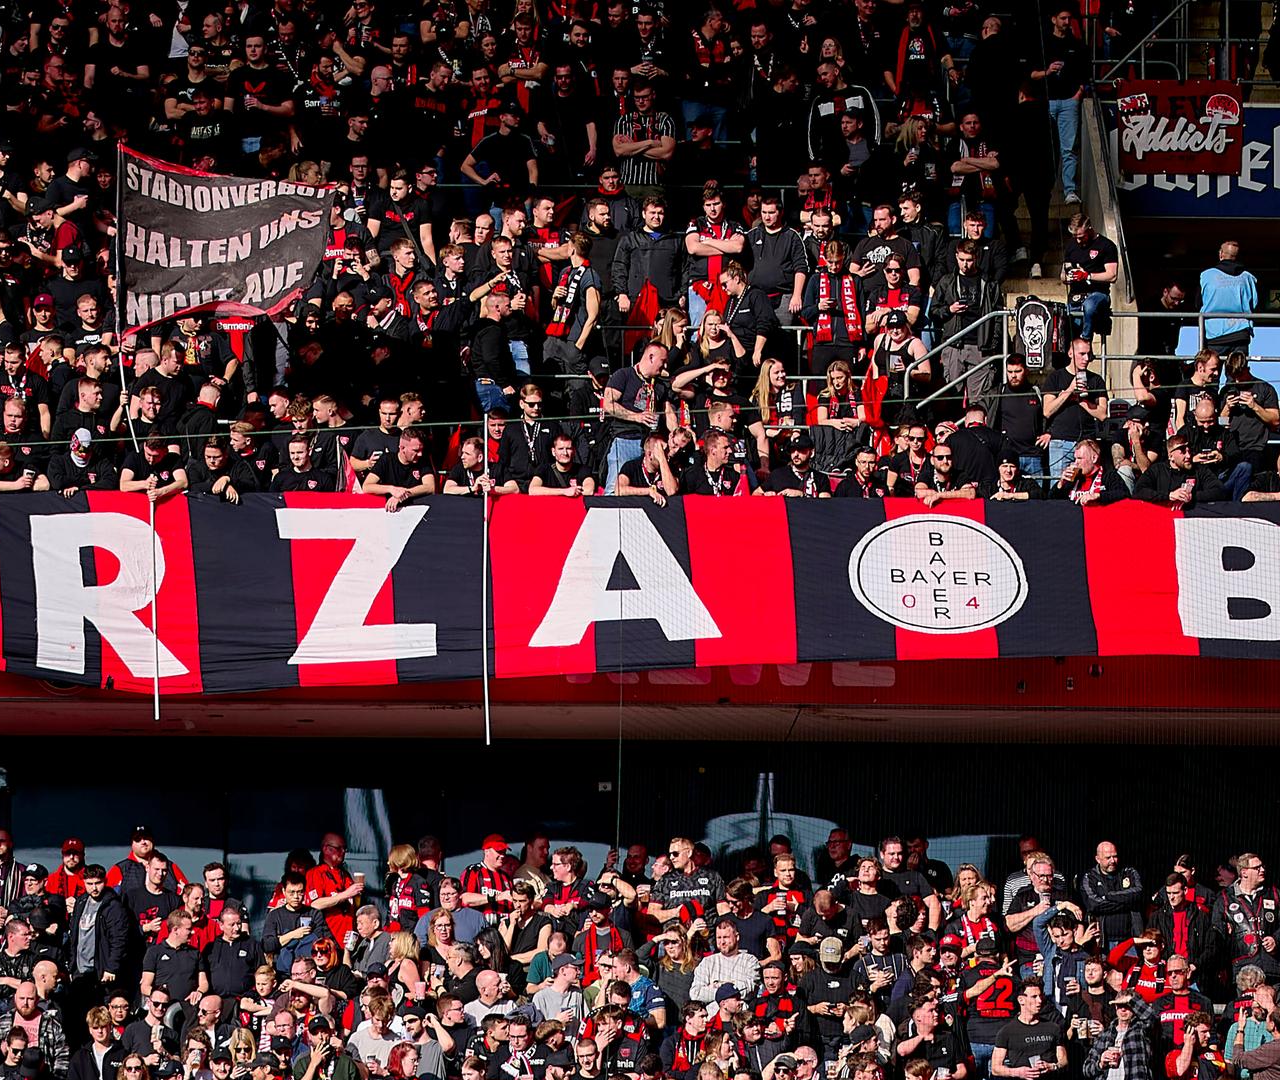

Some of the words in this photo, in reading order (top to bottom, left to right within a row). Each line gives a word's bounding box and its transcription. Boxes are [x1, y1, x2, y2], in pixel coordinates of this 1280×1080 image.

[125, 222, 253, 268] HALTEN
[259, 209, 324, 250] UNS
[240, 261, 304, 304] AUF
[890, 568, 992, 586] BAYER
[928, 532, 951, 619] BAYER
[669, 887, 710, 898] Barmenia
[976, 978, 1015, 1011] 22
